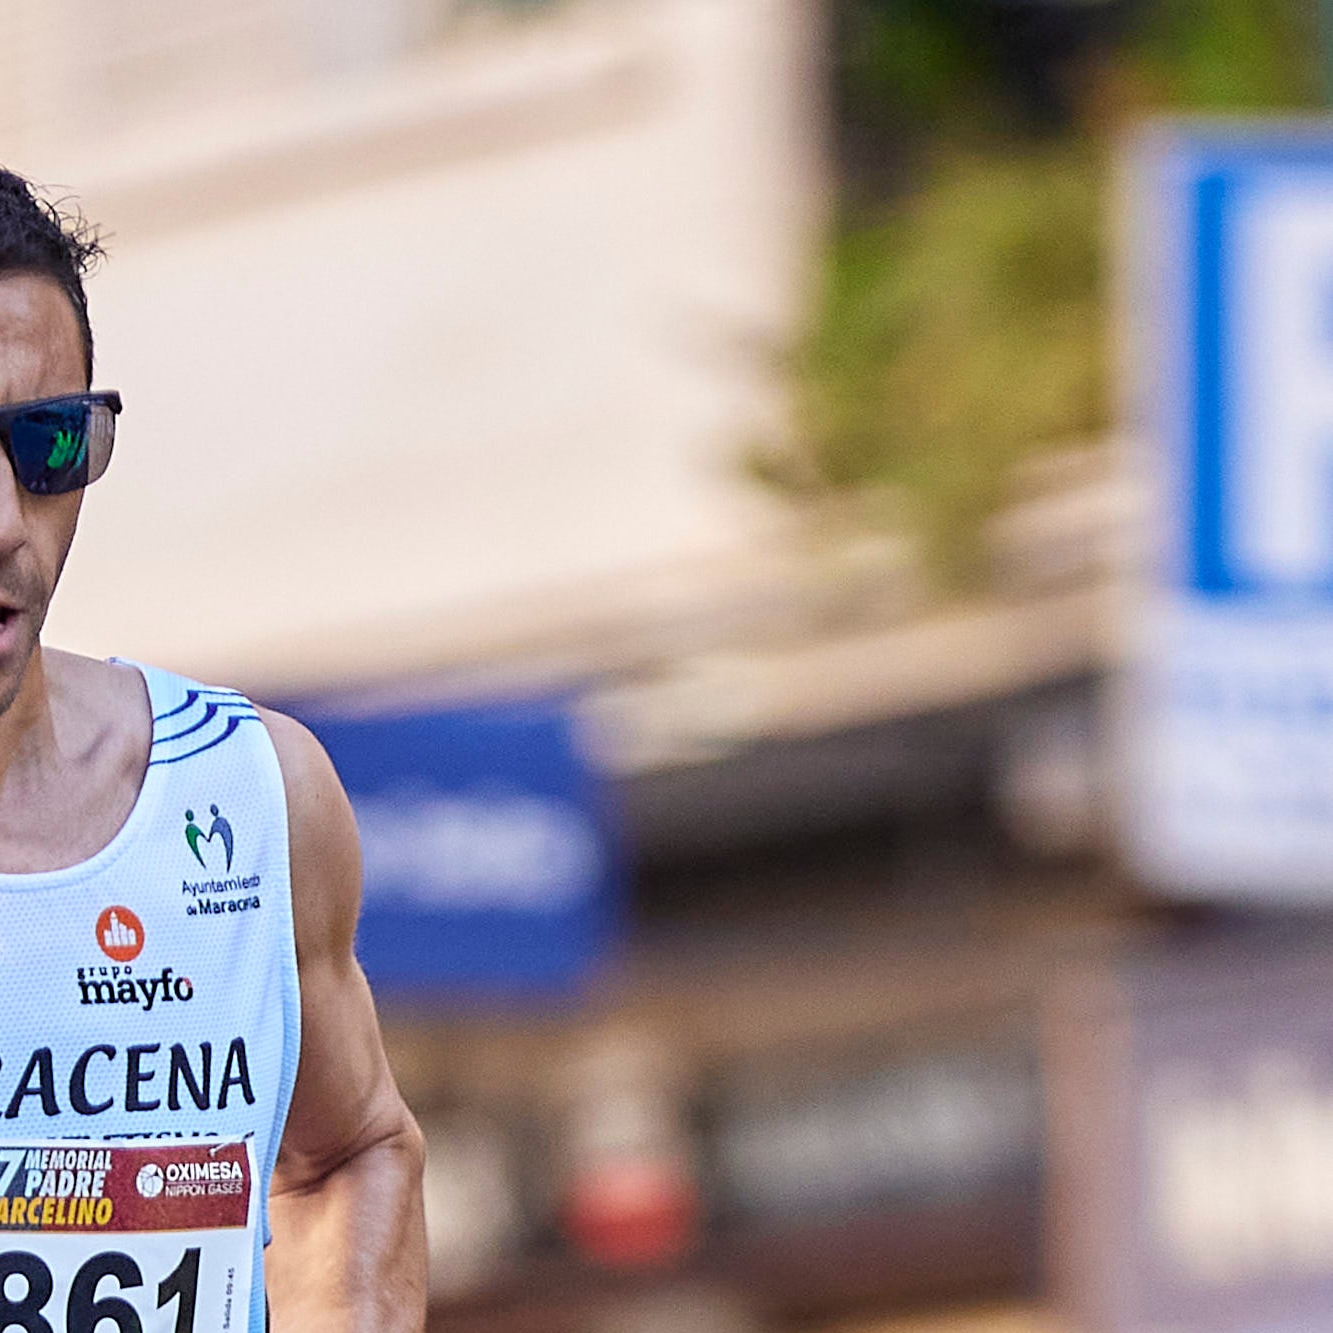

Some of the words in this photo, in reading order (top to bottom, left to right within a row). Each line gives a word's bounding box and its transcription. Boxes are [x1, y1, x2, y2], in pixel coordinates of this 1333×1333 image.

[77, 965, 132, 980] grupo
[78, 967, 193, 1011] mayfo
[24, 1149, 112, 1171] MEMORIAL
[166, 1161, 243, 1182] OXIMESA
[24, 1169, 106, 1198] PADRE
[166, 1184, 206, 1197] NIPPON
[208, 1182, 243, 1195] GASES
